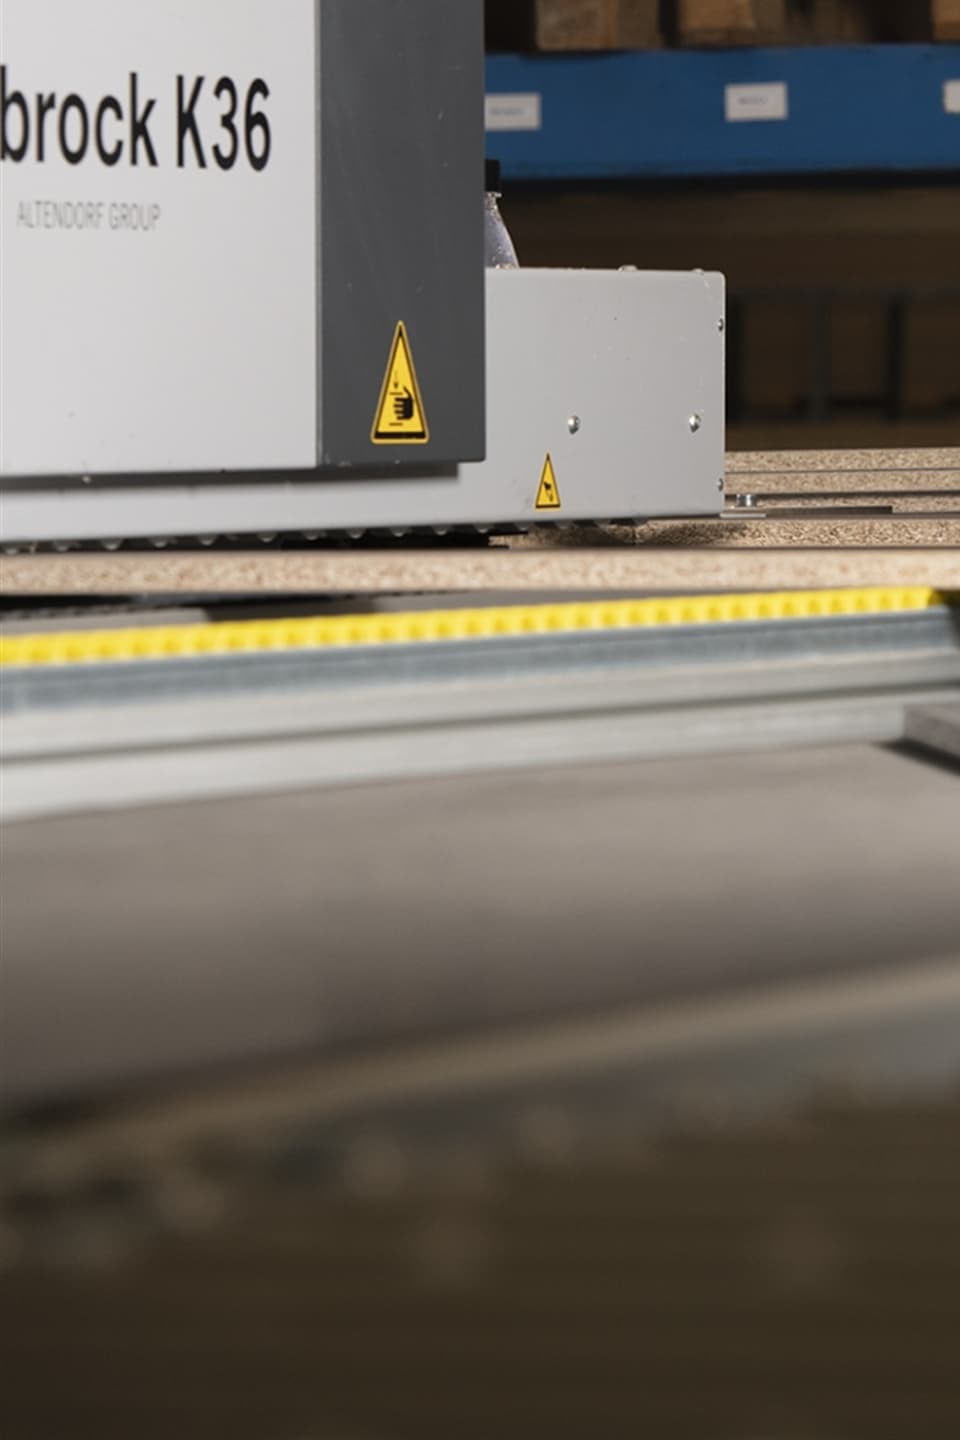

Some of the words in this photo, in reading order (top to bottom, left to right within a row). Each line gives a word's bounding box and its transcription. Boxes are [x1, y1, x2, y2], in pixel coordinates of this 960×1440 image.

[0, 65, 157, 166] brock
[176, 74, 271, 171] K36
[16, 199, 104, 230] ALTENDORF
[108, 202, 161, 231] GROUP
